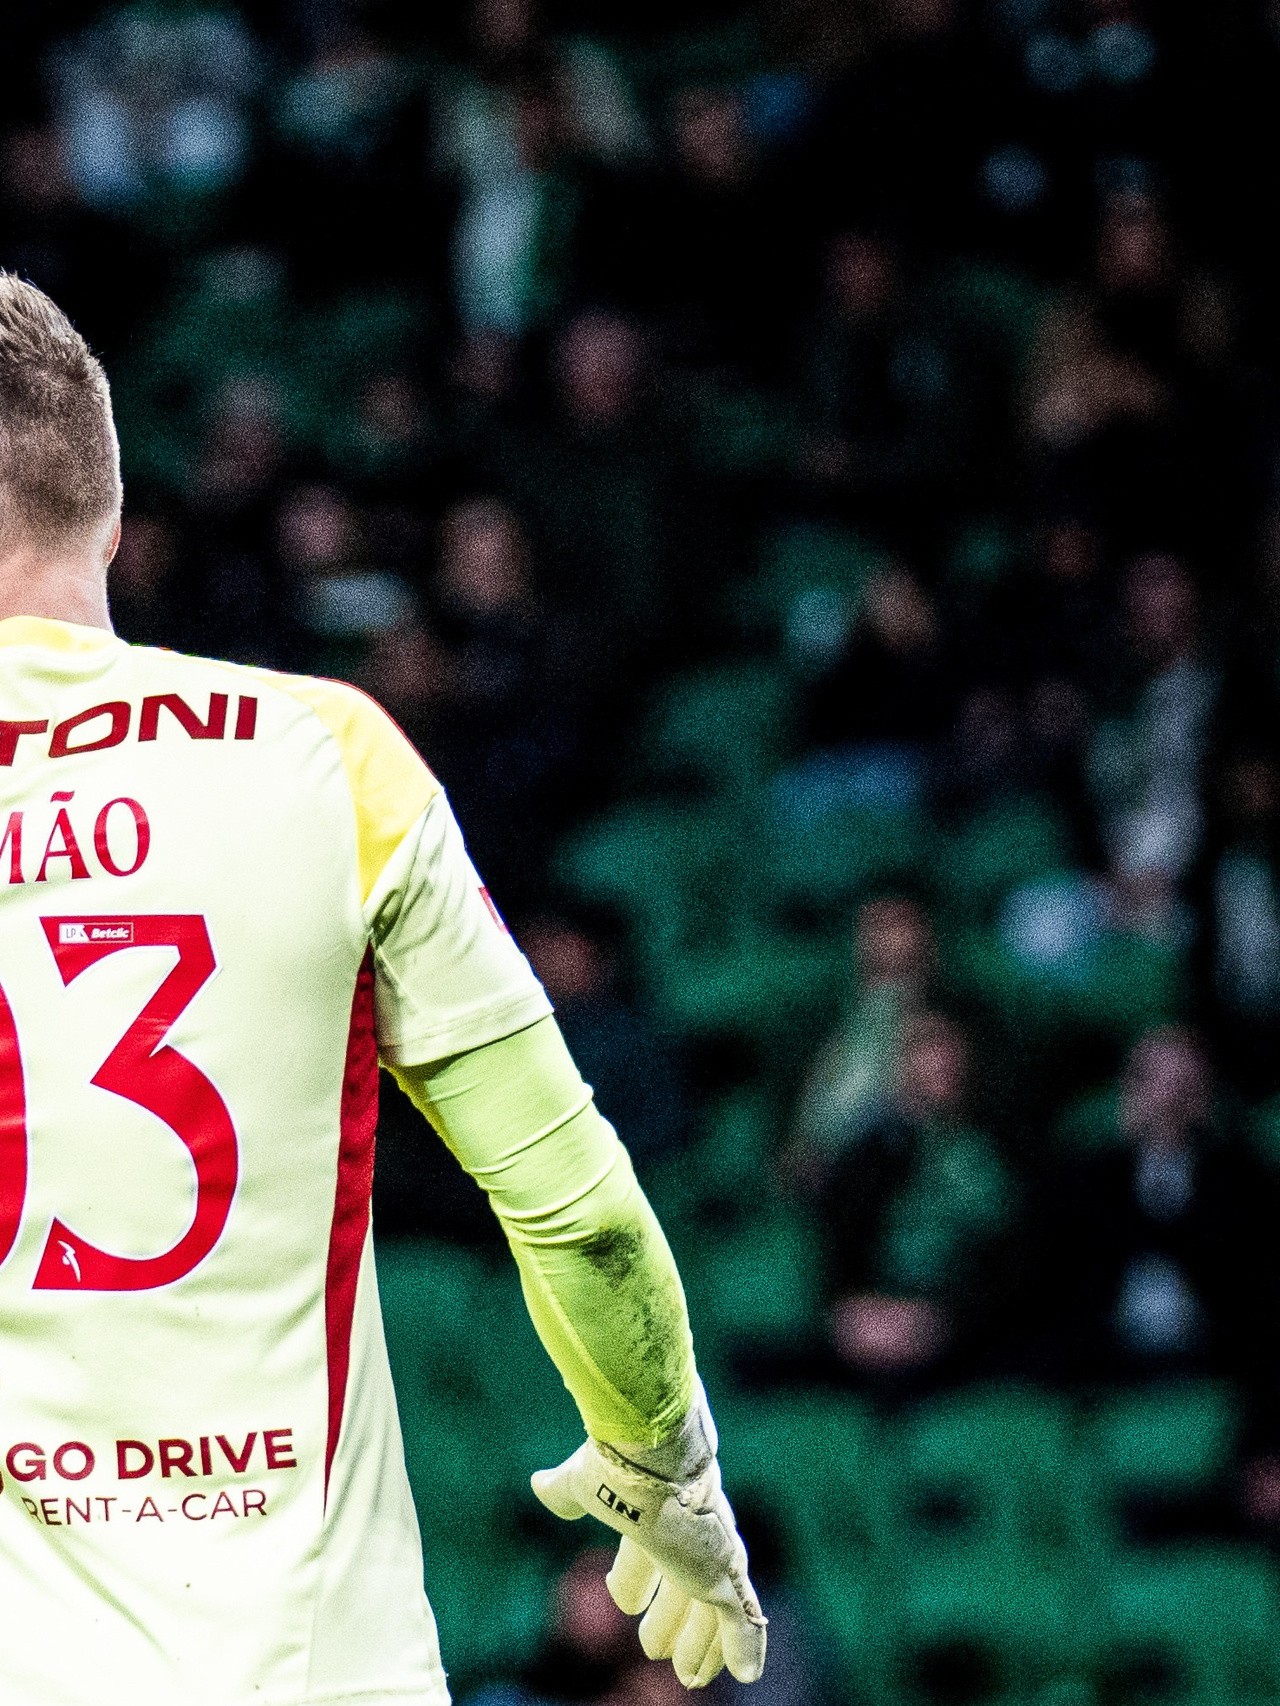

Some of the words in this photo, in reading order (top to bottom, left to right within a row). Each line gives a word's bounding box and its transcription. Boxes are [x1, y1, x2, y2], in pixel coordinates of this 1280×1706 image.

[90, 927, 130, 939] Betclic
[5, 1440, 96, 1482] GO
[117, 1427, 298, 1481] DRIVE
[22, 1489, 268, 1526] RENT-A-CAR
